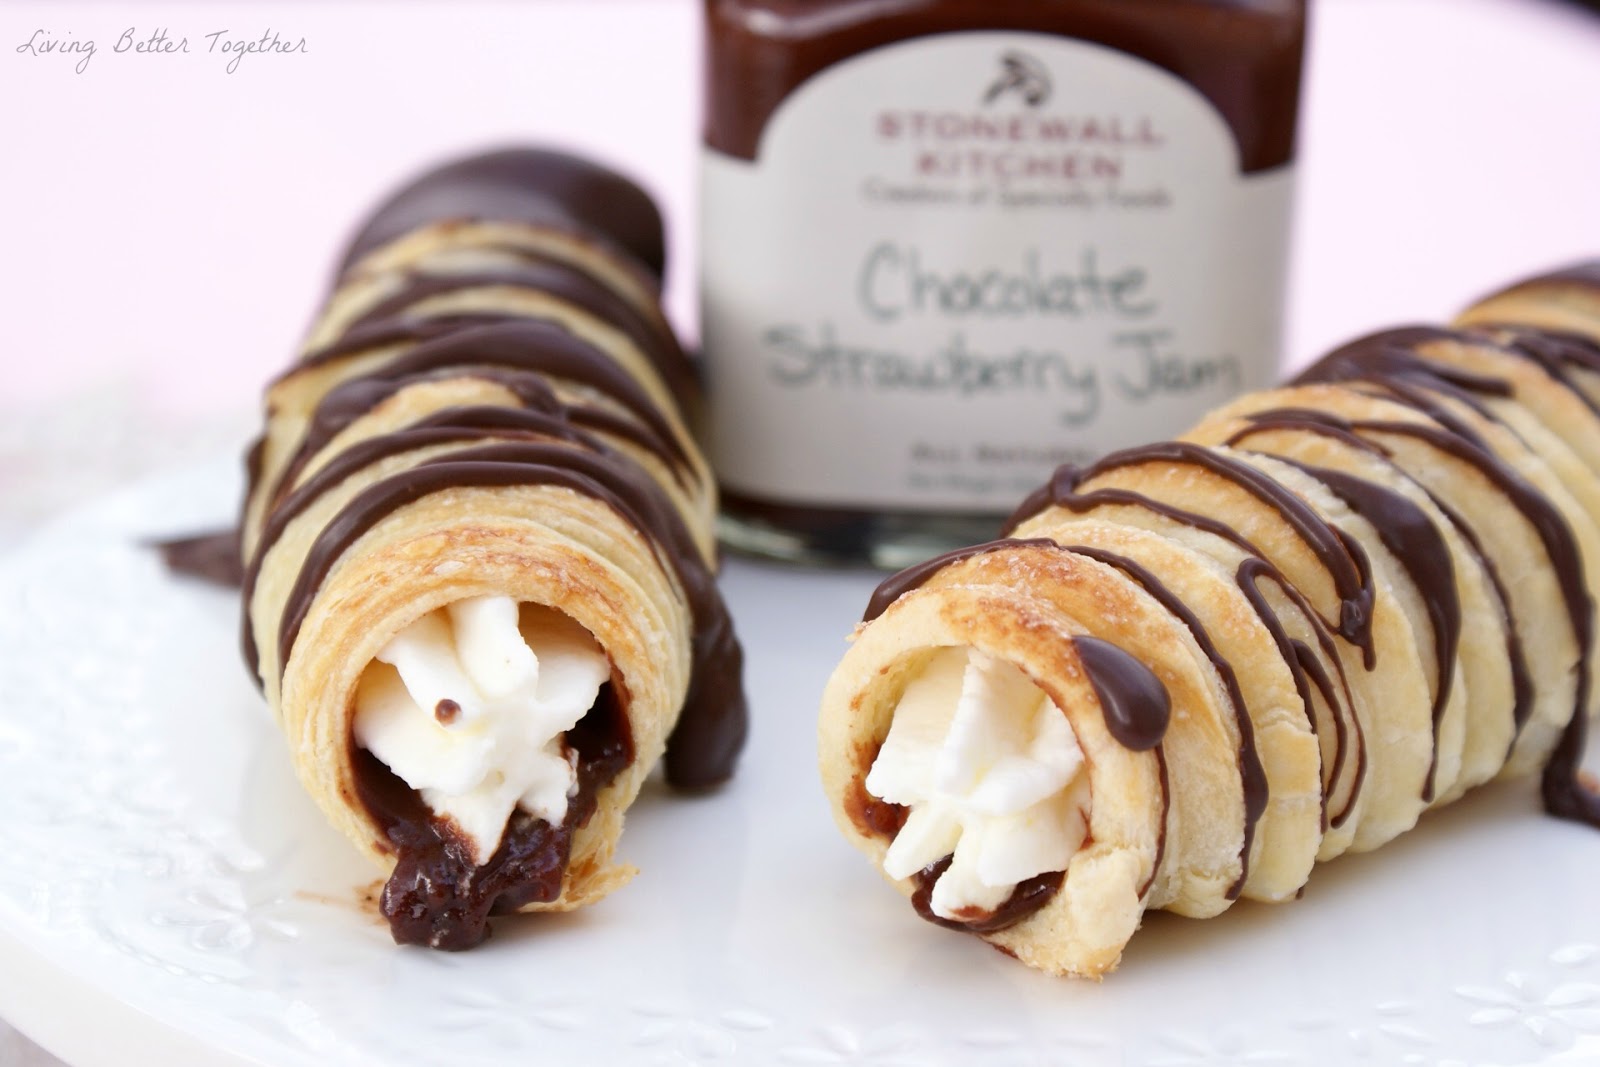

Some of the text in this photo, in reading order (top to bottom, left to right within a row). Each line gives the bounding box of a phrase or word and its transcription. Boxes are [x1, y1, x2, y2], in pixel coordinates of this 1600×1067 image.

[877, 111, 1164, 145] STONEWALL
[916, 152, 1122, 180] KITCHEN
[857, 242, 1158, 322] Chocolate
[763, 322, 1242, 427] Strawberry Jam
